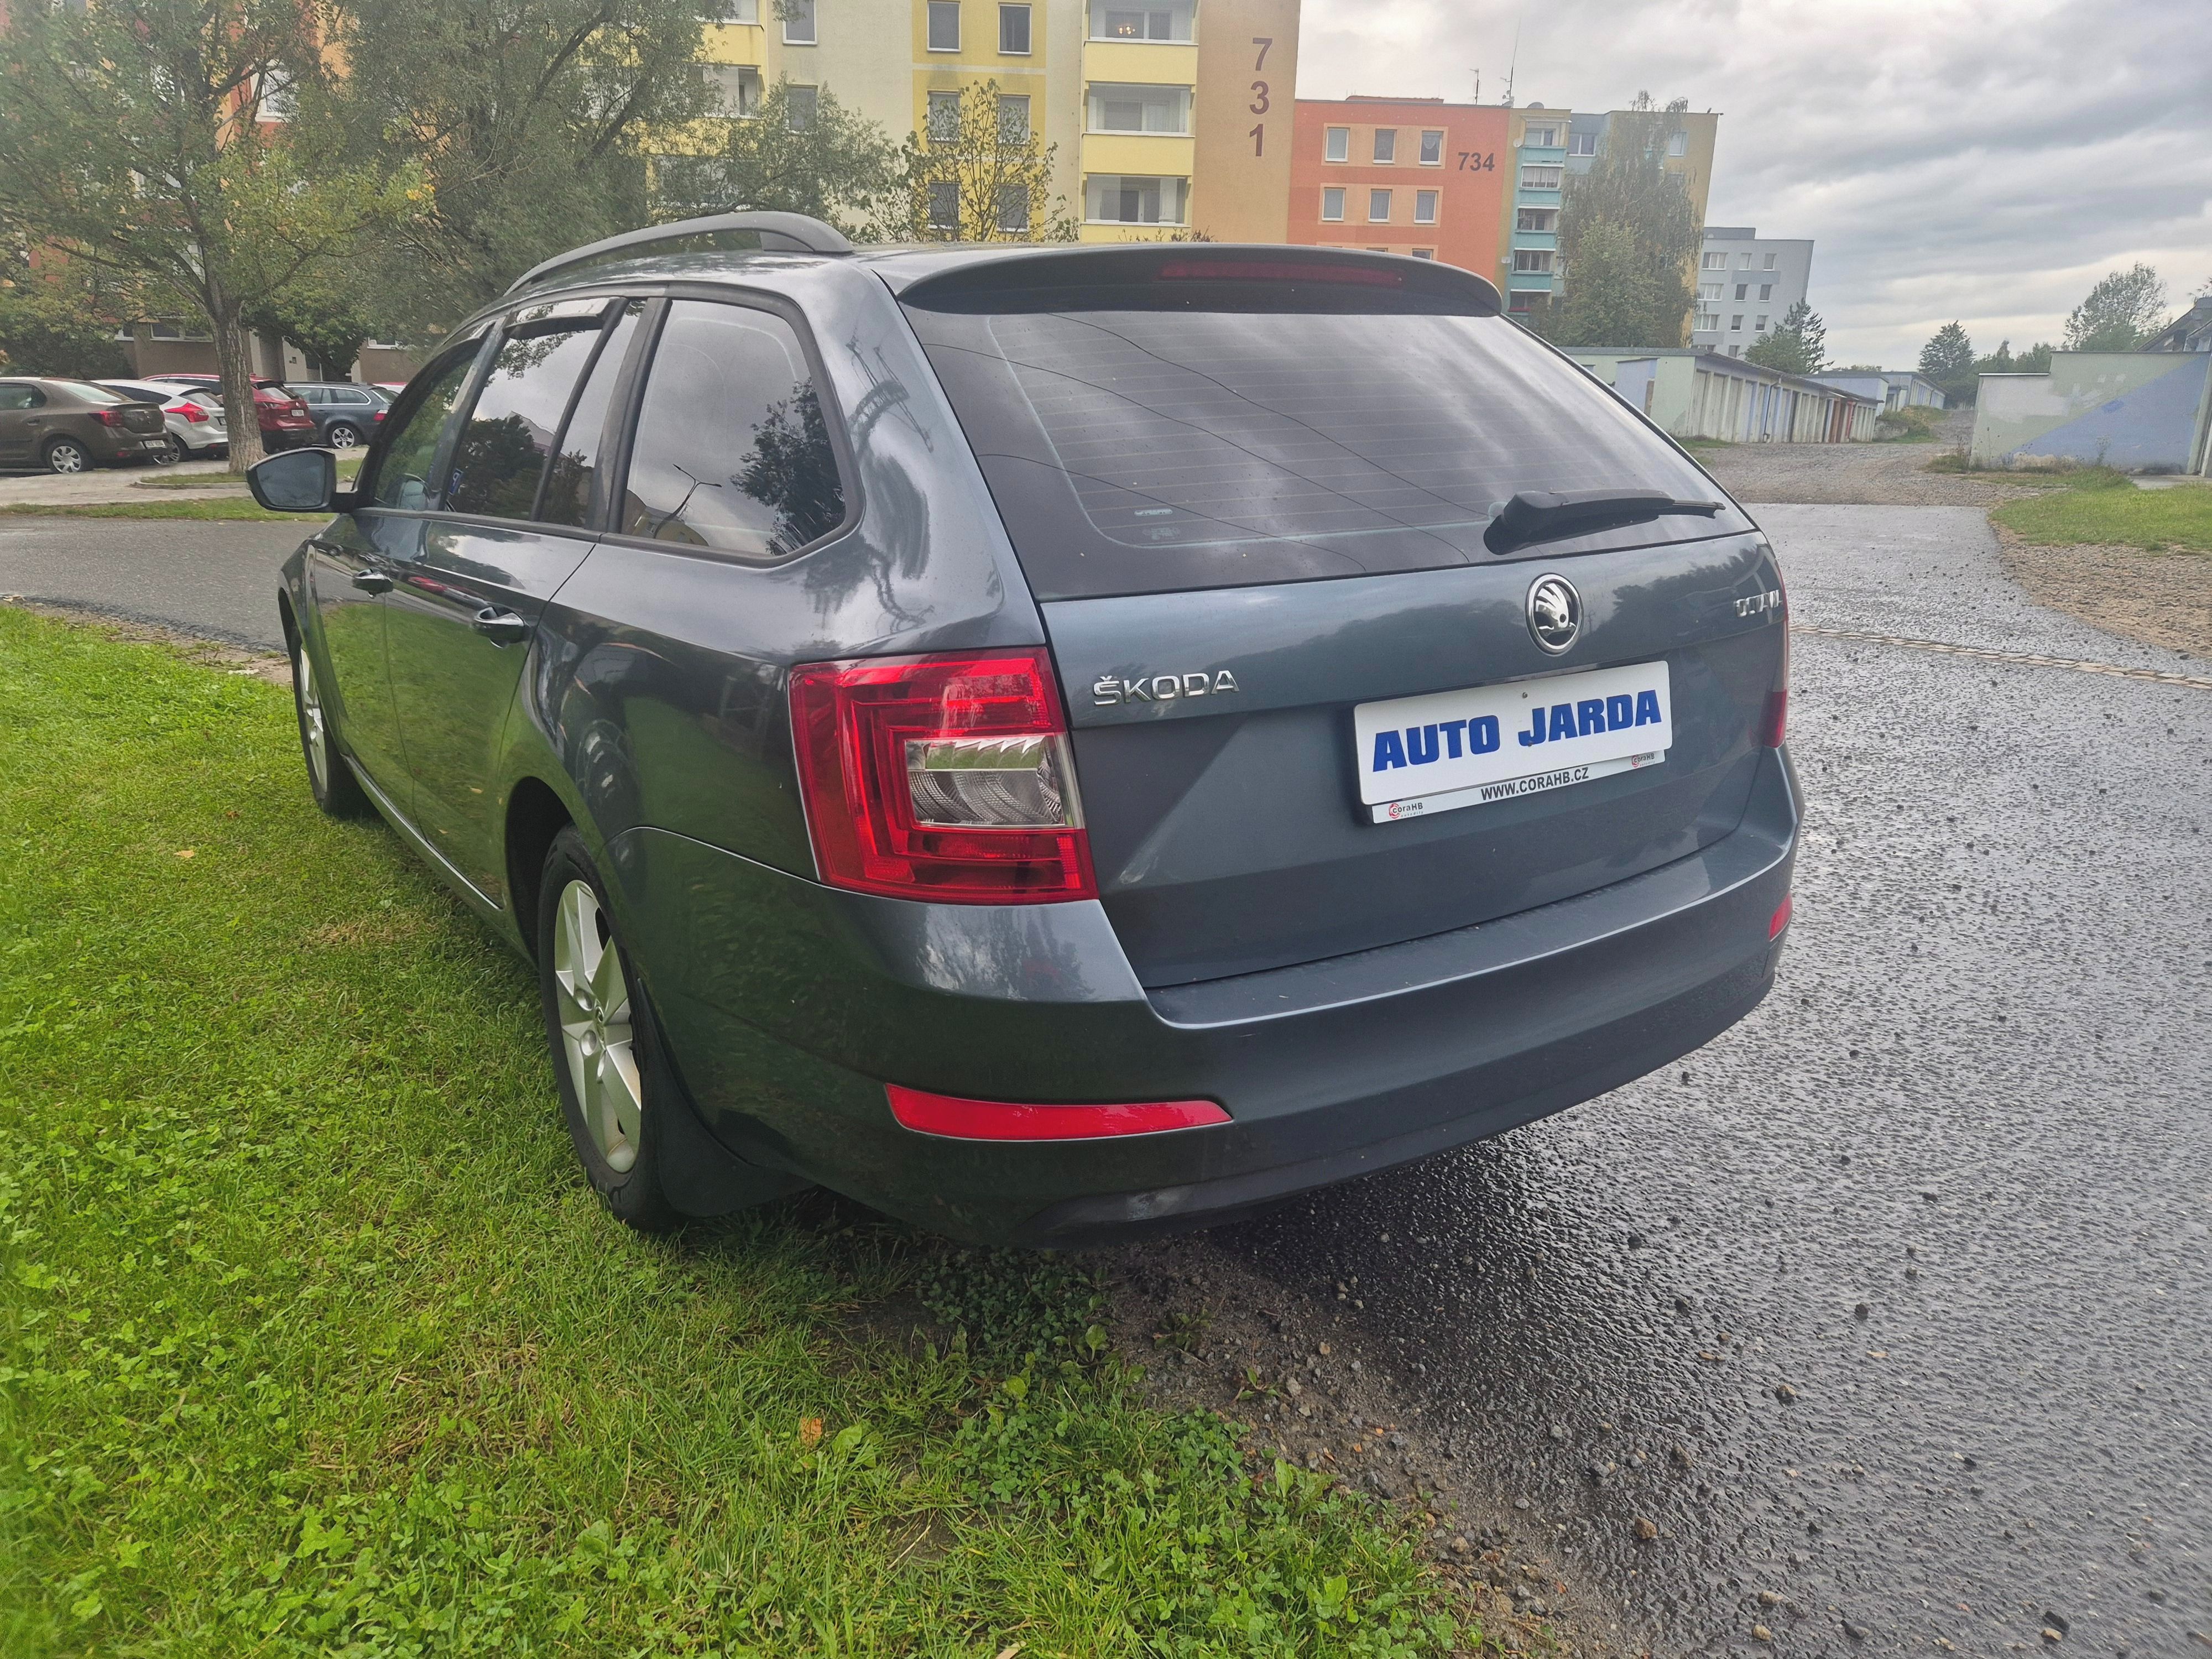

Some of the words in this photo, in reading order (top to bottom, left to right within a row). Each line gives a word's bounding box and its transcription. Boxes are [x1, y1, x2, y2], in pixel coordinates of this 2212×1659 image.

[1458, 152, 1495, 171] 734
[1093, 670, 1239, 706] ŠKODA
[1373, 714, 1500, 773] AUTO
[1518, 690, 1661, 747] JARDA
[1480, 766, 1589, 801] WWW.CORAHB.CZ
